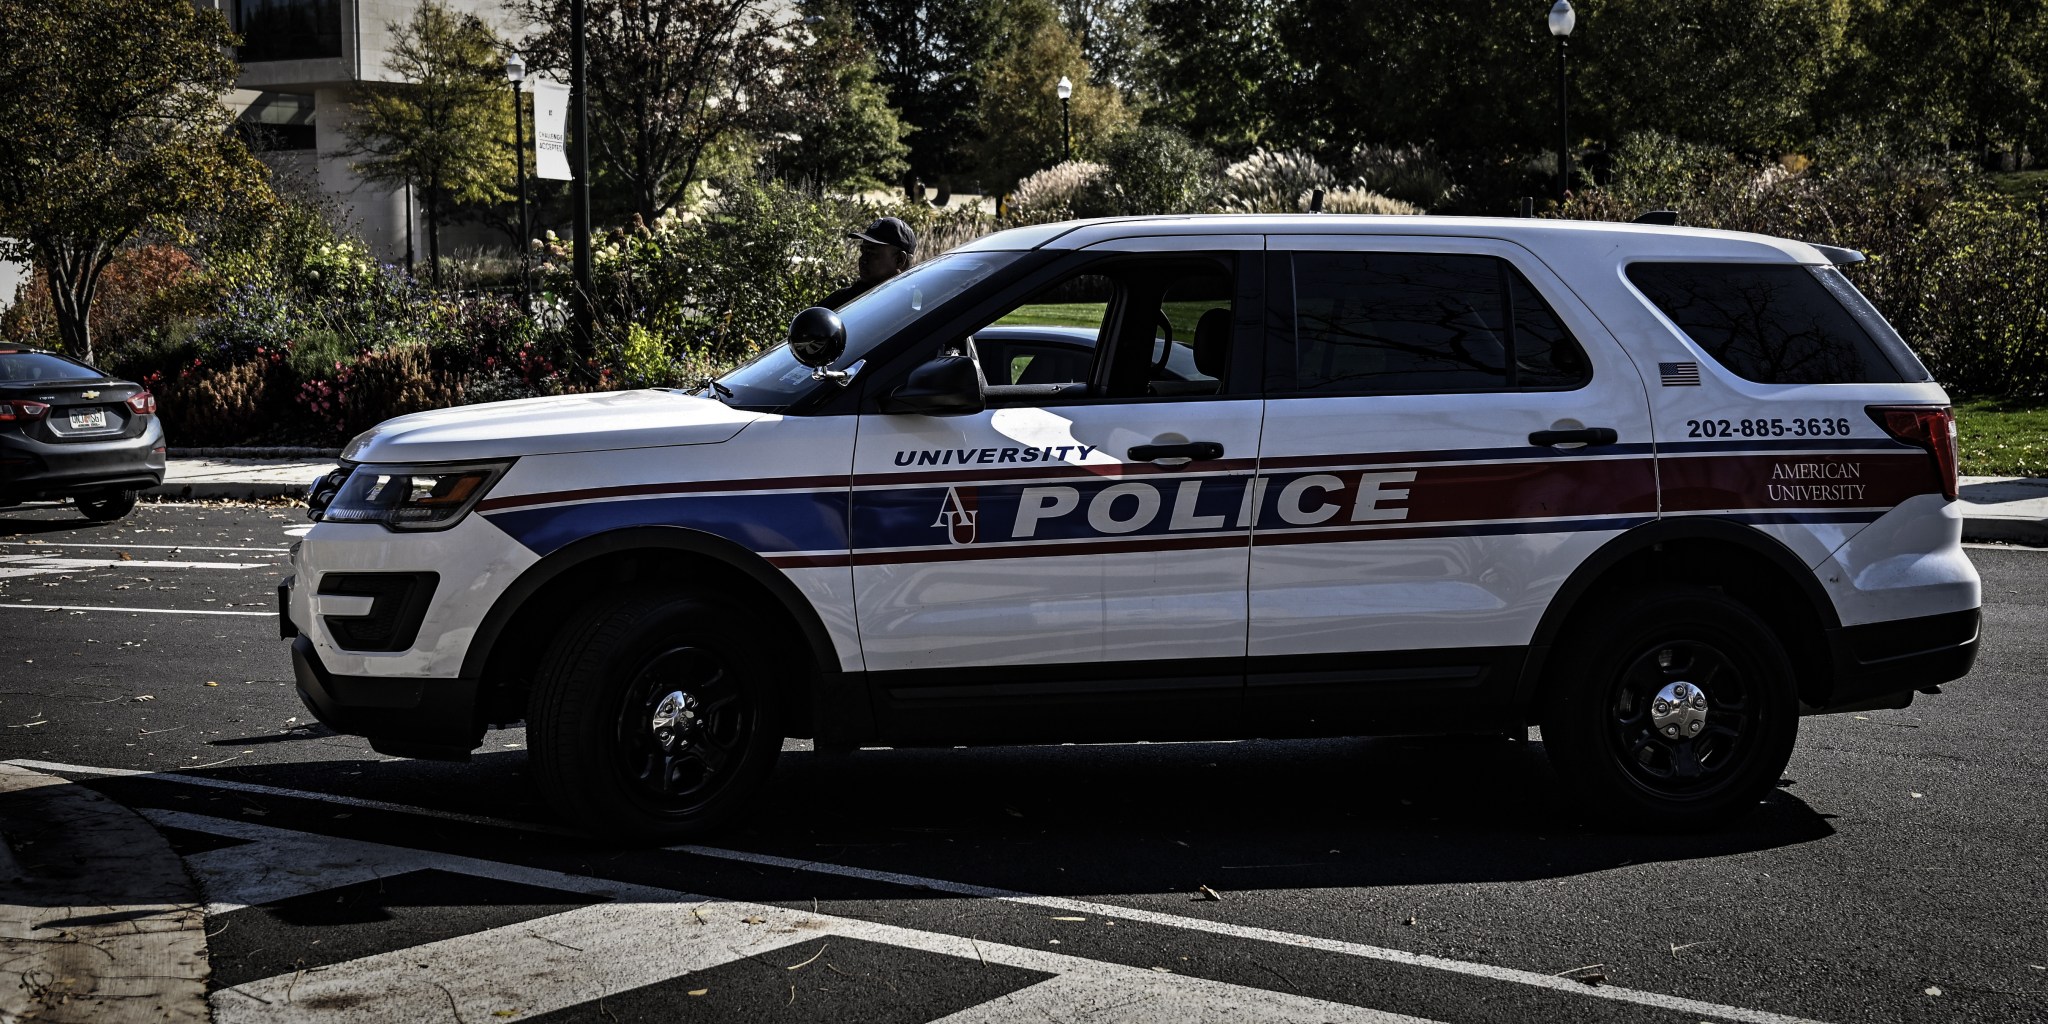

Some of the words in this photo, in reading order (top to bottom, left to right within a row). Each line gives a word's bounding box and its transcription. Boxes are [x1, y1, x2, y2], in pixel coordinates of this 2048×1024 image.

[539, 131, 563, 140] CHALLENGE
[539, 142, 563, 152] ACCEPTED
[1686, 418, 1851, 438] 202-885-3636
[893, 445, 1098, 467] UNIVERSITY
[1771, 462, 1861, 480] AMERICAN
[1767, 484, 1866, 501] UNIVERSITY
[1011, 470, 1418, 538] POLICE
